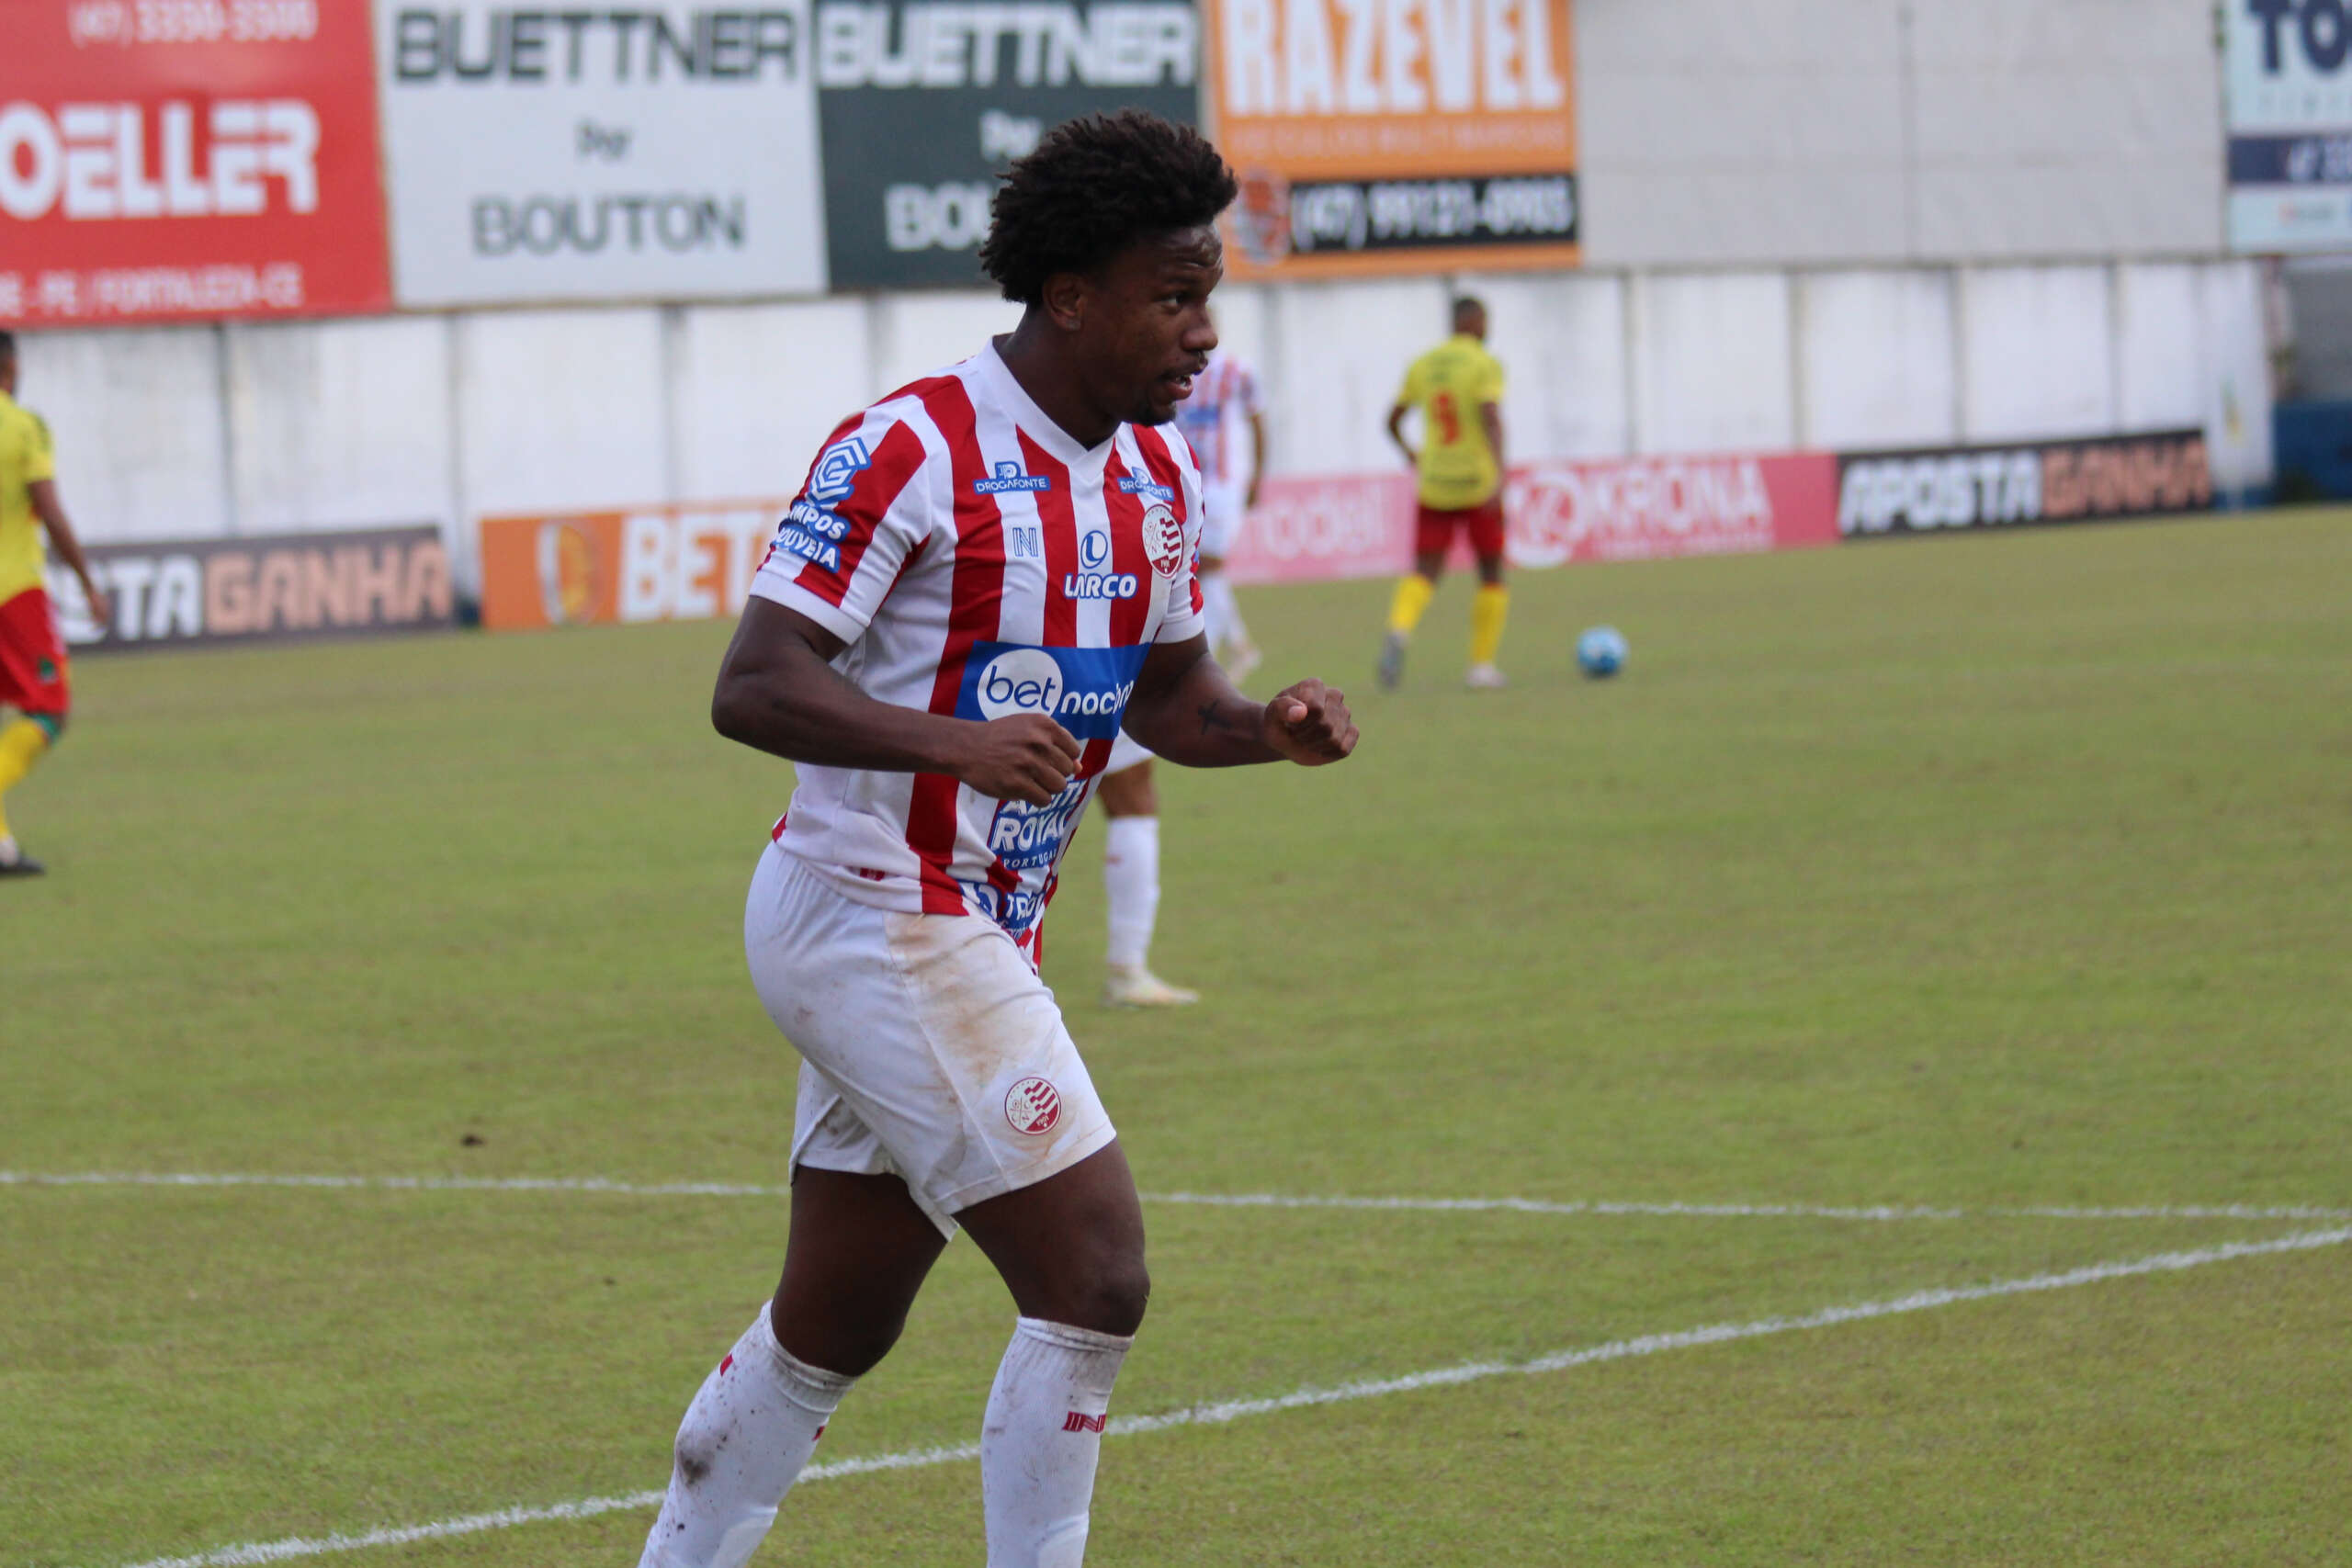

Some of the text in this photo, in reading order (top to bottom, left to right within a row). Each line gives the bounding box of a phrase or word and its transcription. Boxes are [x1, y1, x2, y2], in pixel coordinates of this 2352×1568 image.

[395, 8, 797, 79] BUETTNER
[818, 2, 1198, 88] BUETTNER
[1223, 0, 1566, 116] RAZEVEL
[471, 192, 745, 256] BOUTON
[1290, 182, 1367, 251] (47)
[976, 478, 1047, 493] DROGAFONTE
[1838, 435, 2212, 535] APOSTA GANHA
[204, 540, 452, 635] GANHA
[1064, 573, 1138, 599] LARCO
[986, 665, 1056, 712] bet
